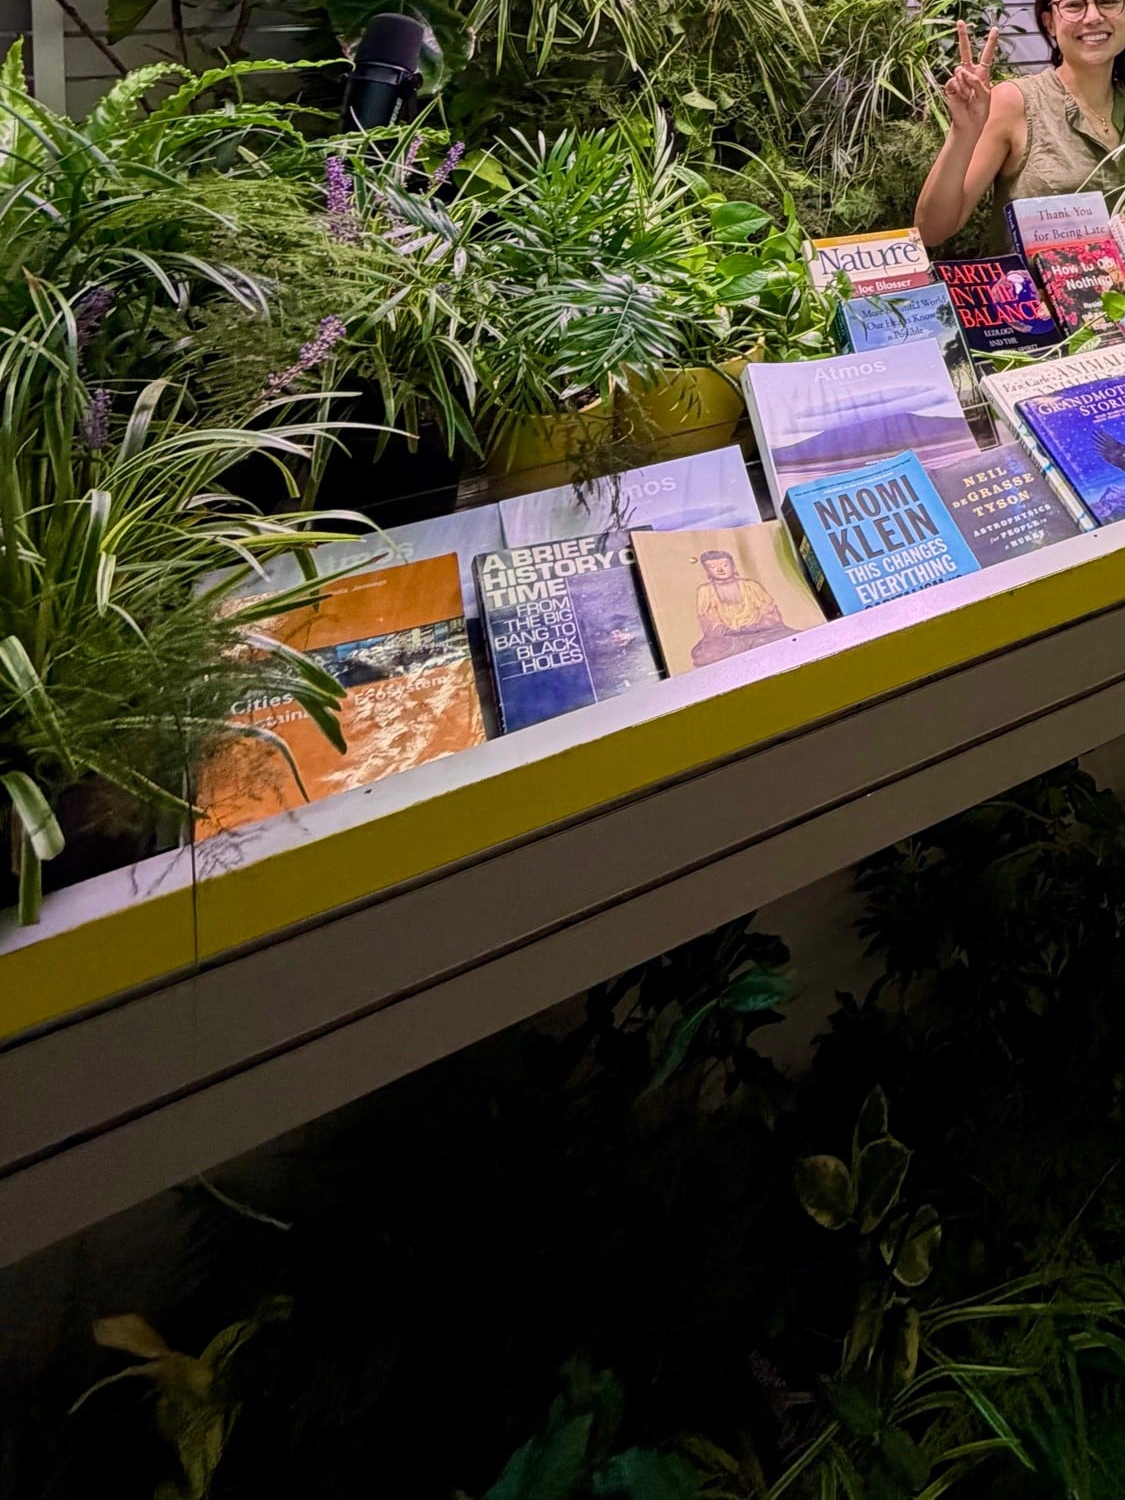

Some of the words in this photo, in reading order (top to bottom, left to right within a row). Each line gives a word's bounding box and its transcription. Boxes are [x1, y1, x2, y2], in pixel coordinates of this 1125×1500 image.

[1038, 207, 1071, 221] Thank
[1073, 206, 1093, 218] You
[1034, 229, 1049, 242] for
[1050, 227, 1082, 241] Being
[1084, 224, 1106, 236] Late
[818, 242, 921, 275] Nature
[1051, 264, 1079, 276] How
[1081, 261, 1095, 272] to
[876, 278, 913, 292] Blosser
[939, 263, 1006, 284] EARTH
[1066, 275, 1113, 291] Nothing
[921, 295, 946, 307] World
[950, 287, 976, 306] IN
[974, 283, 1019, 305] THE
[957, 300, 1044, 328] BALANCE
[866, 322, 884, 331] Our
[814, 360, 887, 383] Atmos
[962, 466, 1007, 487] NEIL
[813, 474, 921, 531] NAOMI
[972, 490, 1031, 517] TYSON
[973, 504, 1051, 538] ASTROPHYSICS
[1000, 519, 1041, 539] PEOPLE
[827, 503, 940, 567] KLEIN
[1009, 529, 1046, 548] HURRY
[482, 554, 507, 573] A
[511, 537, 596, 567] BRIEF
[845, 561, 882, 585] THIS
[882, 537, 949, 573] CHANGES
[483, 550, 613, 591] HISTORY
[855, 555, 957, 605] EVERYTHING
[486, 578, 566, 608] TIME
[516, 596, 570, 618] FROM
[503, 614, 542, 633] THE
[543, 609, 573, 627] BIG
[494, 629, 550, 651] BANG
[550, 622, 576, 639] TO
[516, 636, 579, 661] BLACK
[521, 650, 584, 674] HOLES
[230, 693, 295, 715] Cities
